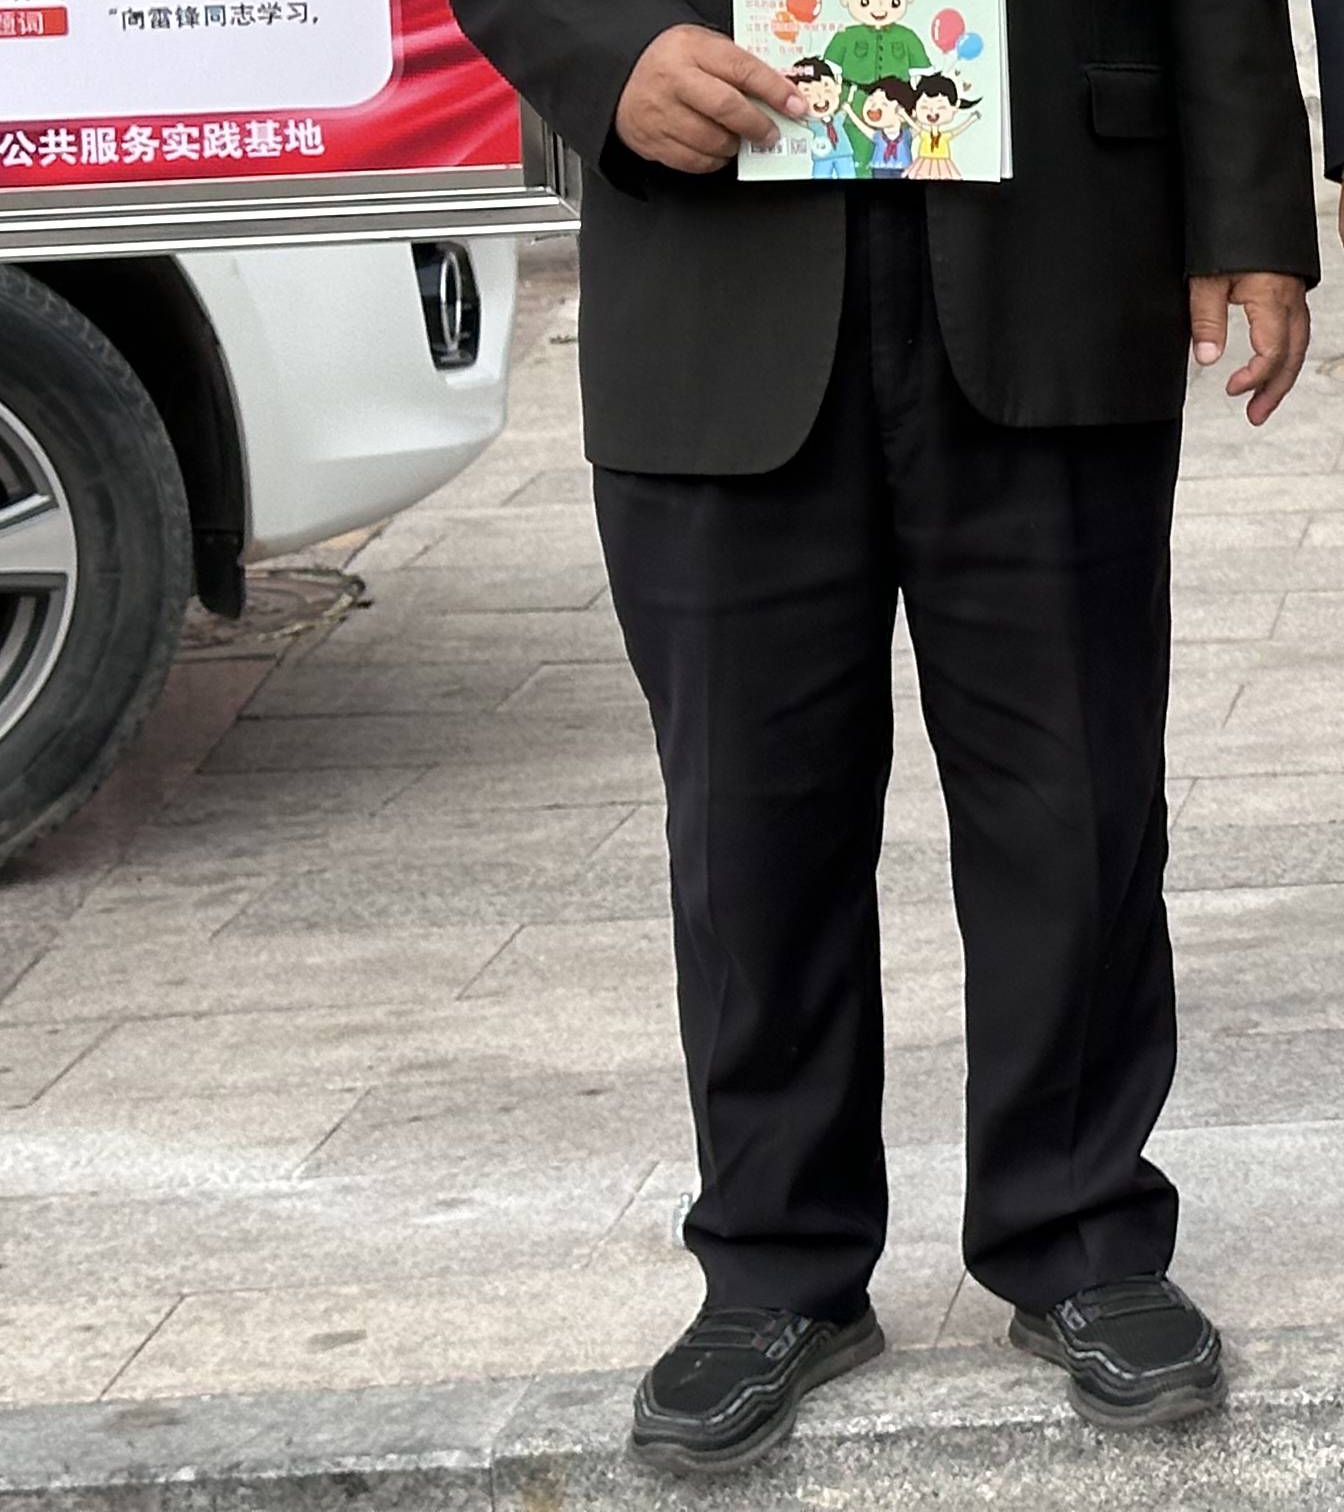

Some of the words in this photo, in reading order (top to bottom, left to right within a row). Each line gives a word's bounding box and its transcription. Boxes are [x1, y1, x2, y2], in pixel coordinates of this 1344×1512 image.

[1, 118, 325, 167] 公共服务实践基地
